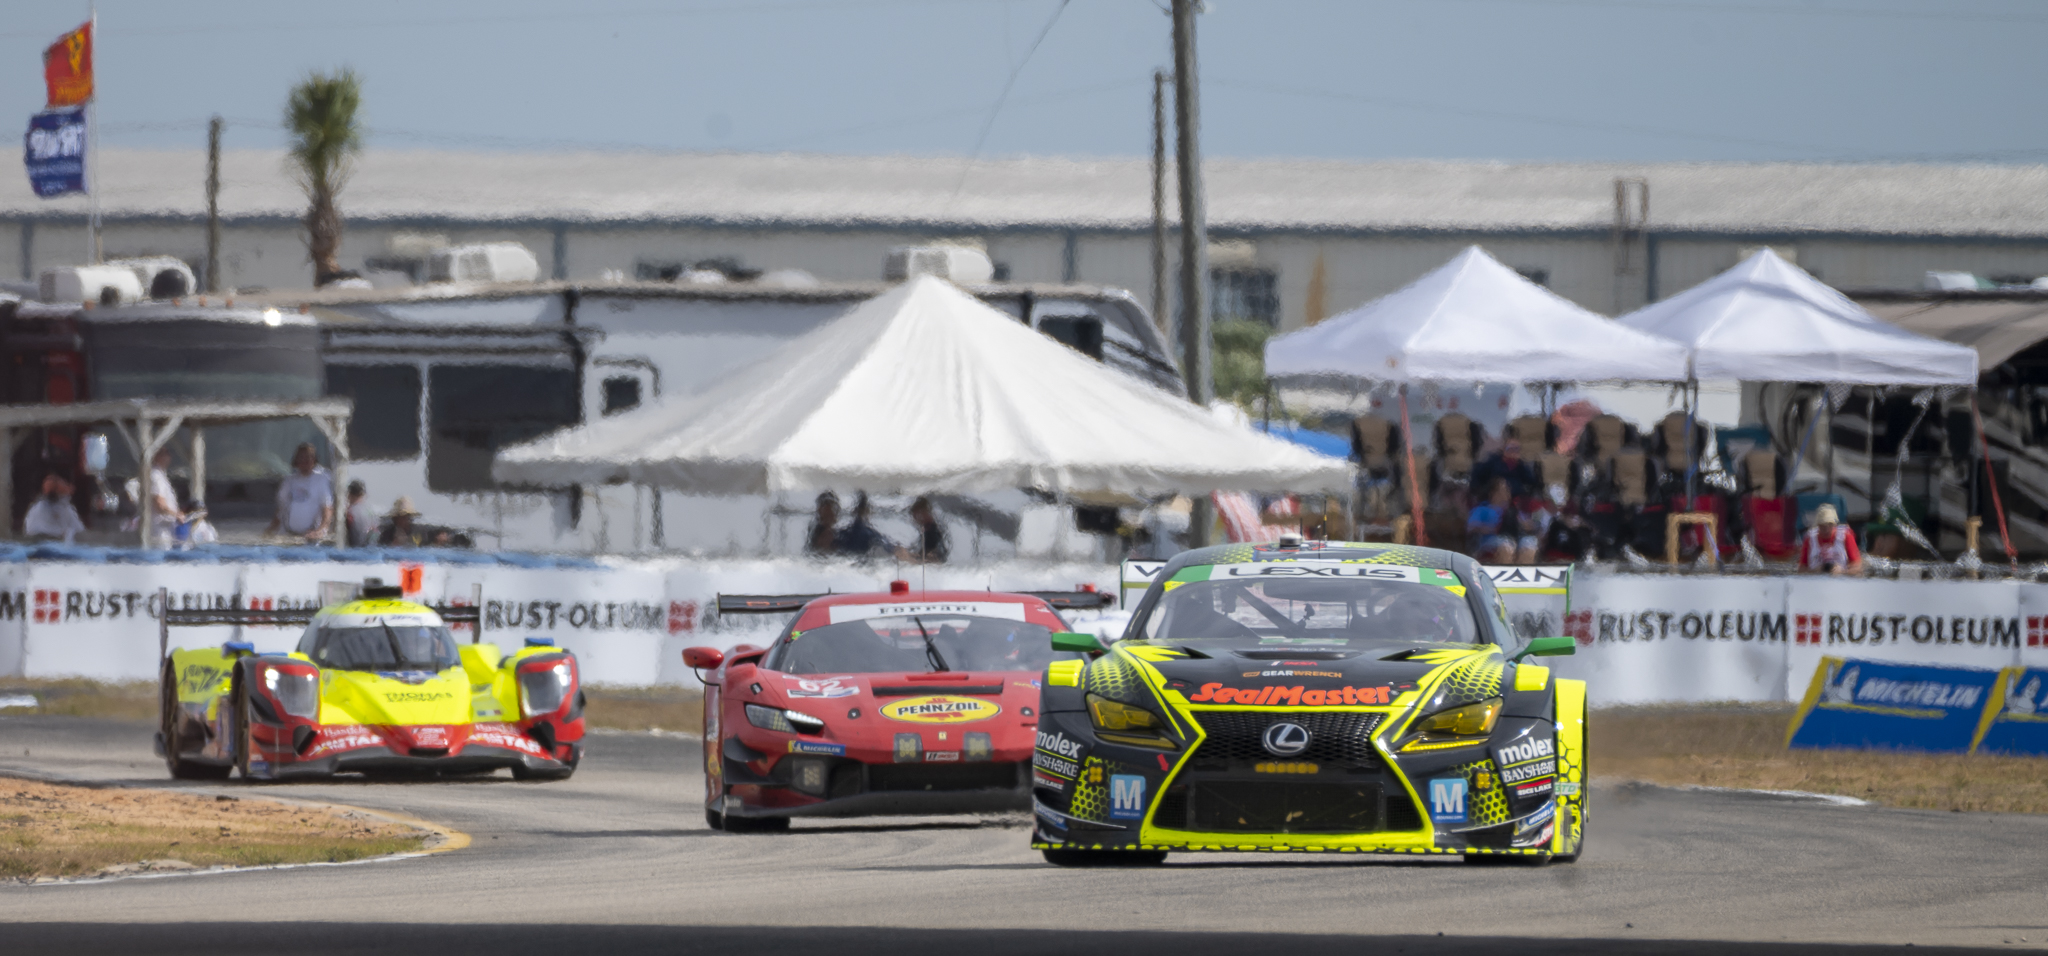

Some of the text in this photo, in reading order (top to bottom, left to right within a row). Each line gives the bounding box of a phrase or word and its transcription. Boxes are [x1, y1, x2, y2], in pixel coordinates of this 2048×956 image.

[1229, 566, 1406, 579] LEXUS
[1828, 614, 2020, 647] RUST-OLEUM
[1262, 670, 1342, 678] GEARWRENCH
[1190, 682, 1390, 706] SealMaster
[1857, 678, 1983, 709] MICHELIN
[897, 702, 982, 716] PENNZOIL
[1035, 731, 1081, 758] molex
[1499, 736, 1554, 765] molex
[1114, 779, 1141, 810] M
[1435, 783, 1463, 813] M
